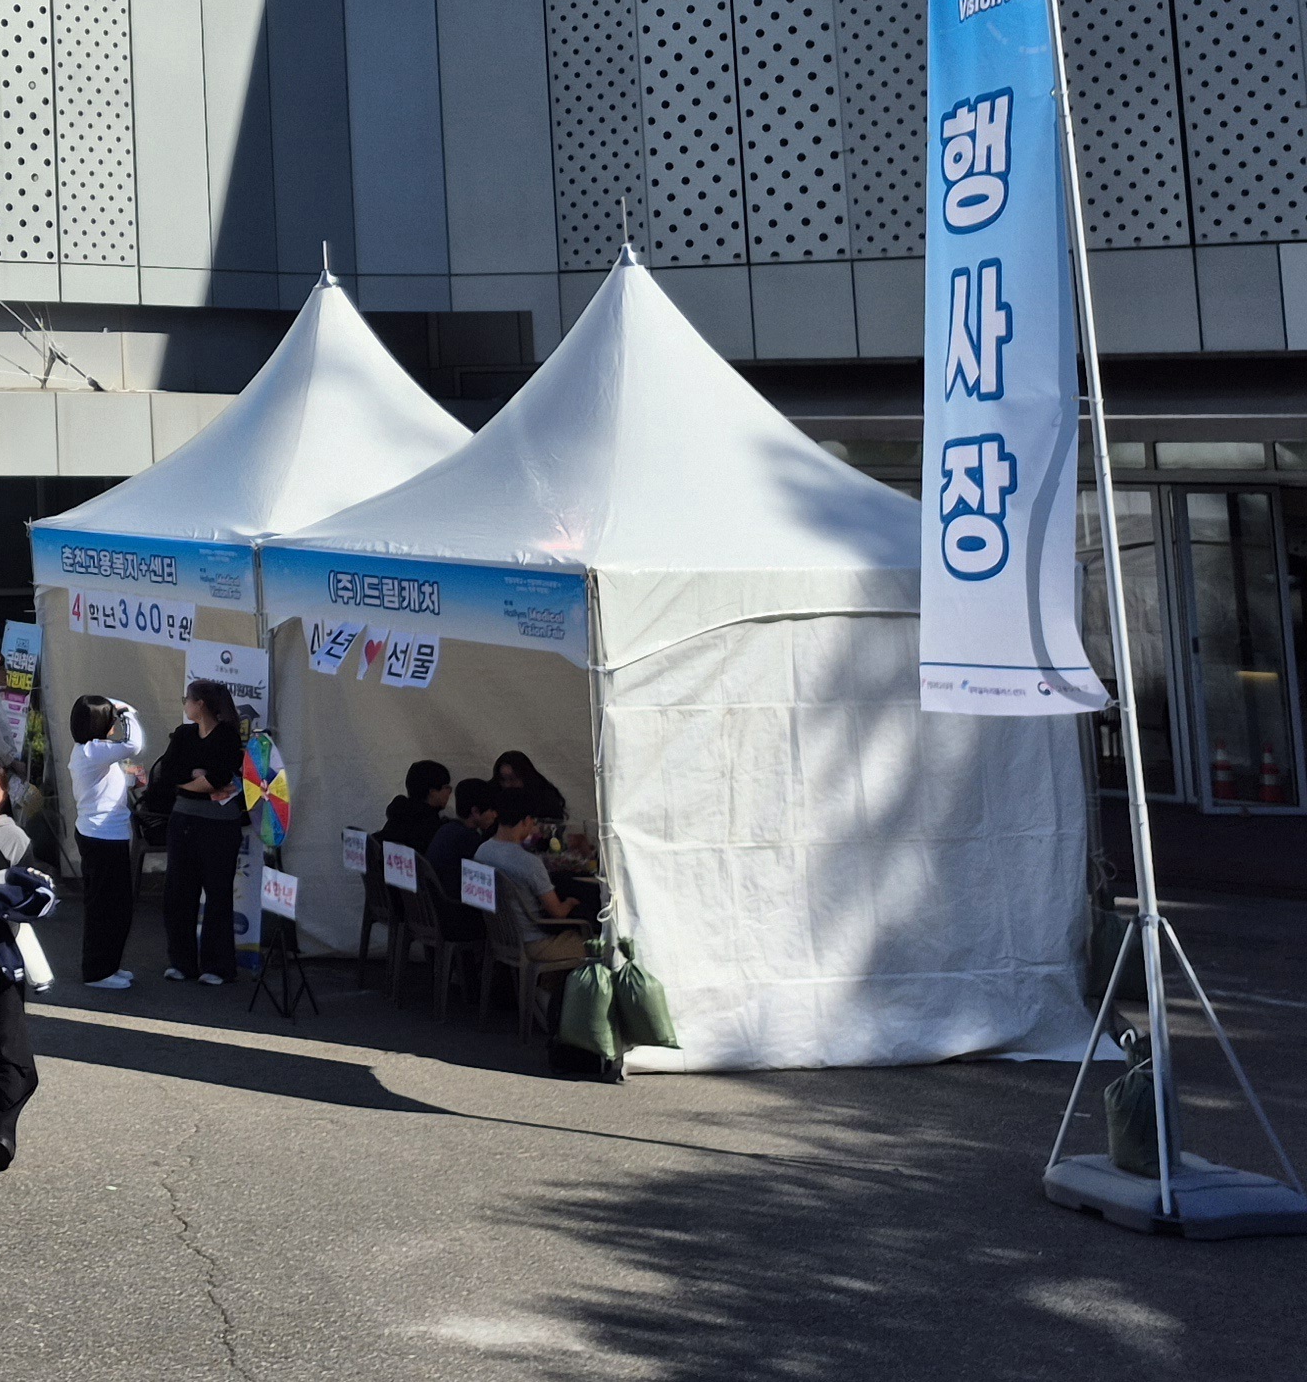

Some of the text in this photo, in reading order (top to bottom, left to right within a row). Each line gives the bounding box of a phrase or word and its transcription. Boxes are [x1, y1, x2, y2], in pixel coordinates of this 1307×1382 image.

[940, 84, 1019, 583] 행사장
[61, 545, 178, 585] 춘천고용복지+센터
[328, 570, 440, 615] (주)드림캐처
[387, 641, 434, 680] 선물
